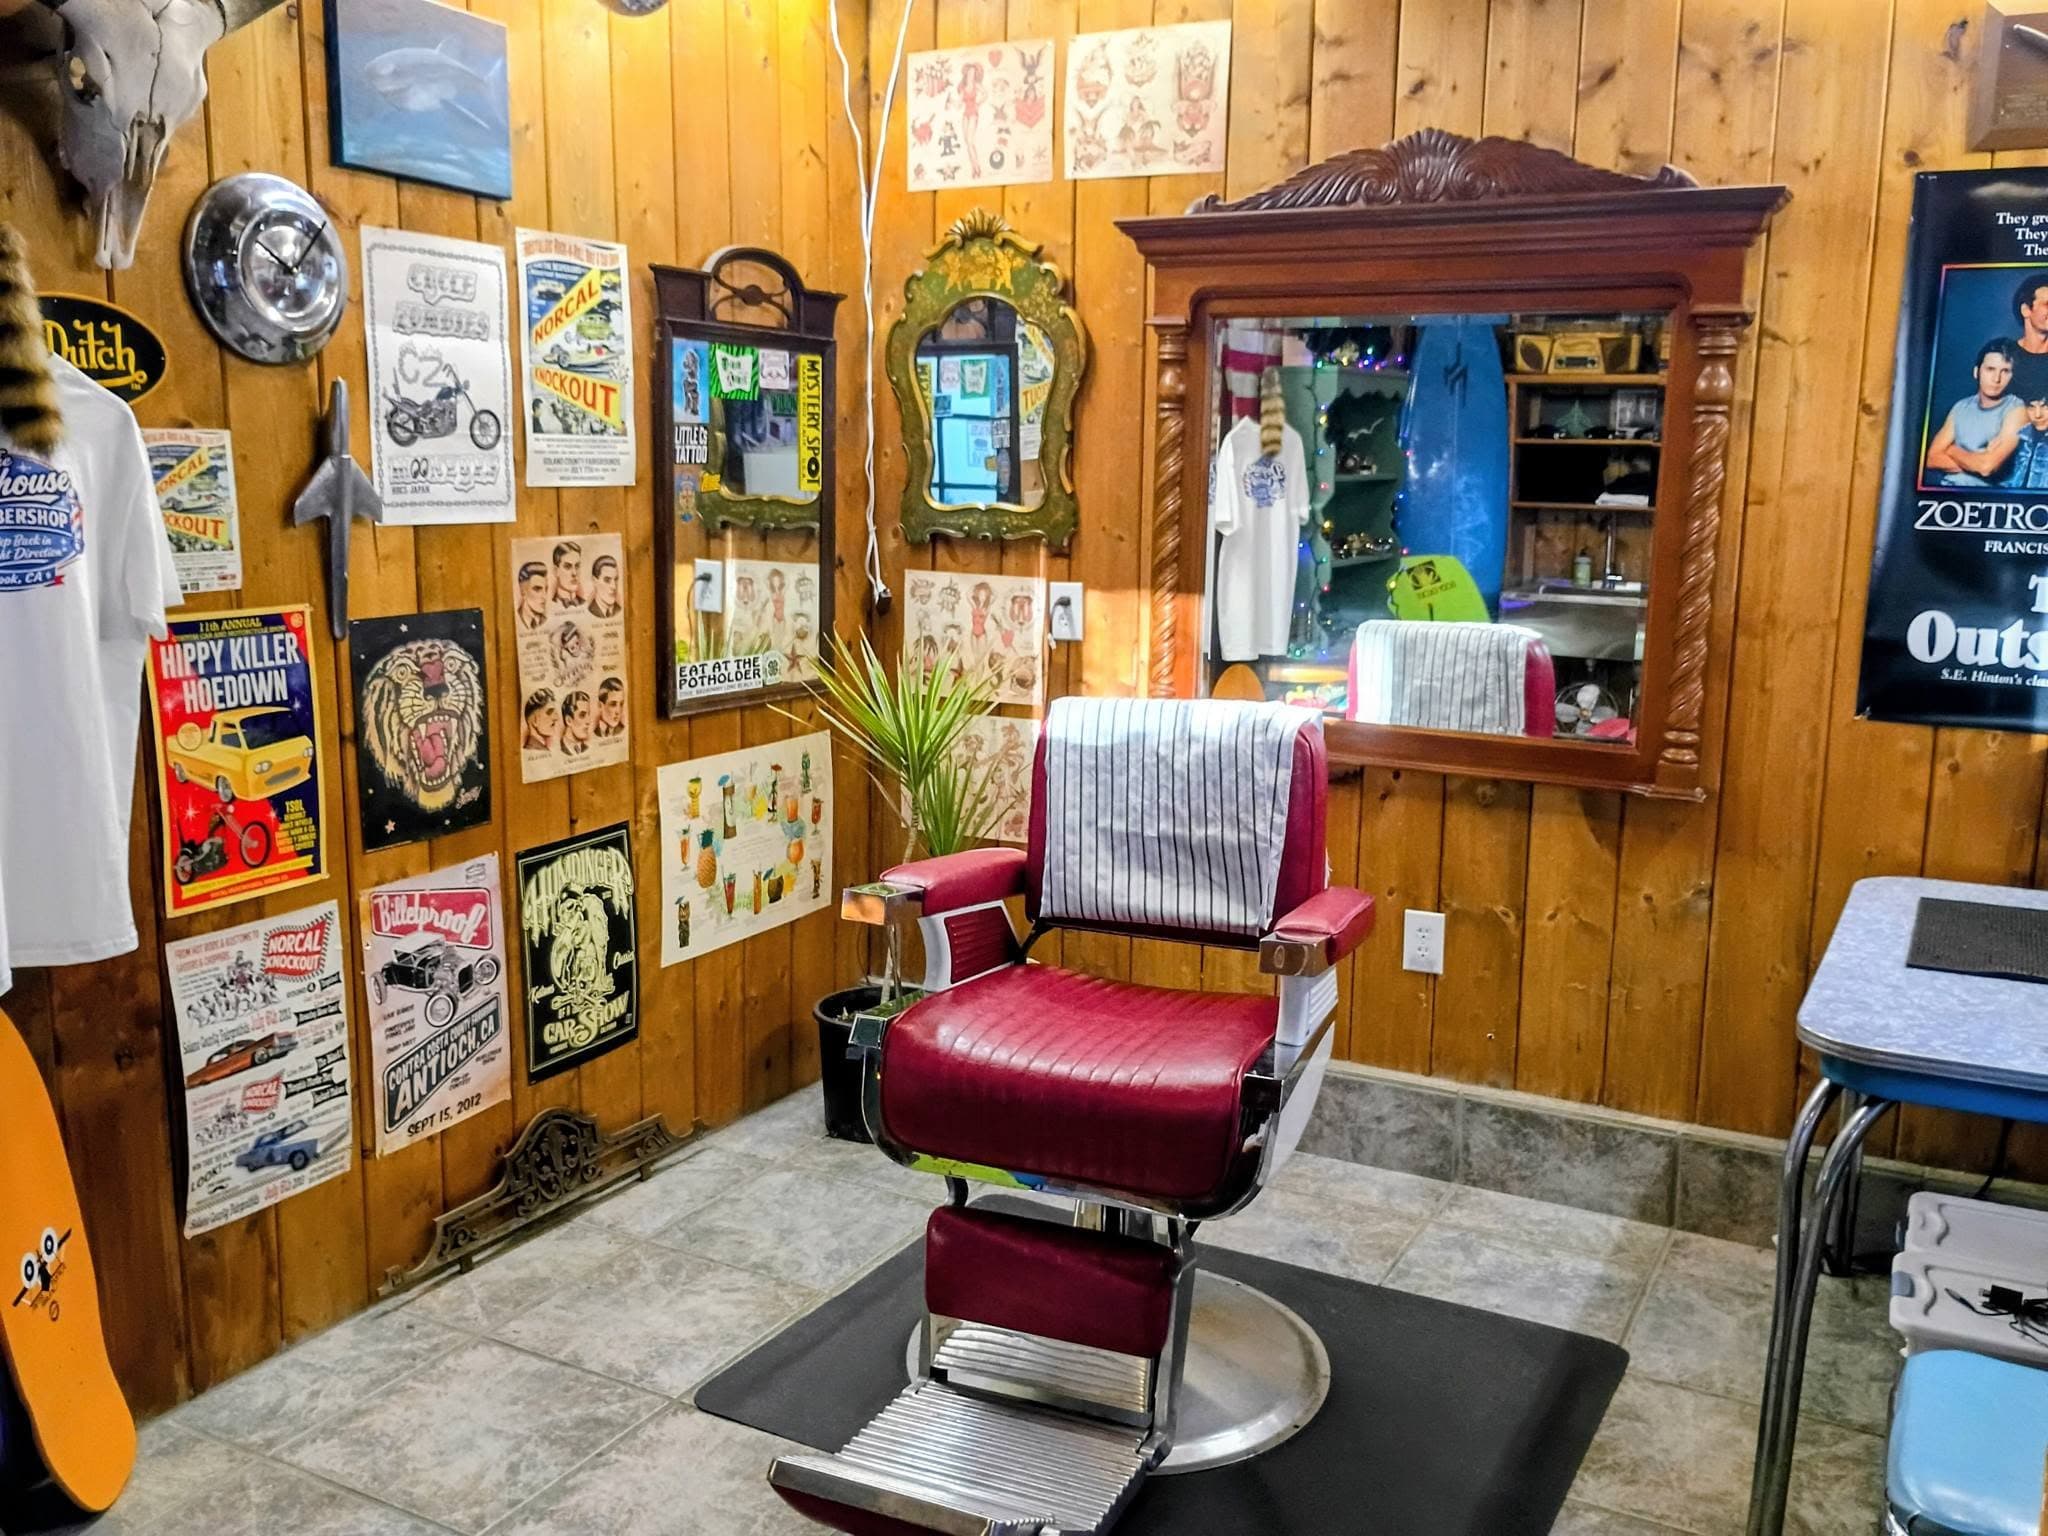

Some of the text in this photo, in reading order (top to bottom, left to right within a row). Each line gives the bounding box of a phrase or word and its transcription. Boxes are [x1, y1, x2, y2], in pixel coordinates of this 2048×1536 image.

[1996, 212, 2028, 226] They
[2015, 228, 2048, 242] They
[534, 280, 599, 343] NORCAL
[43, 319, 136, 374] Dutch
[398, 343, 447, 388] CZ
[534, 367, 617, 417] KNOCKOUT
[675, 426, 699, 445] LITTLE
[806, 359, 820, 484] MYSTERY SPOT
[675, 445, 708, 464] TATTOO
[157, 455, 206, 493] ORCAL
[164, 513, 224, 540] CKOUT
[1984, 540, 2048, 554] FRANCIS
[25, 571, 42, 584] CA
[221, 617, 262, 631] ANNUAL
[160, 632, 301, 680] HIPPY KILLER
[679, 656, 760, 677] EAT AT THE
[182, 669, 289, 714] HOEDOWN
[679, 668, 761, 690] POTHOLDER
[1941, 668, 1967, 681] S.E.
[1971, 670, 2022, 685] Hinton's
[373, 893, 486, 944] Billetproof
[268, 928, 322, 954] NORCAL
[264, 953, 321, 971] KNOCKOUT
[543, 1019, 577, 1045] CAR
[568, 990, 630, 1048] SHOW
[389, 1050, 425, 1091] CONTRA
[426, 1032, 449, 1060] COSTA
[394, 1027, 481, 1120] ANTIOCH,
[481, 1014, 495, 1041] CA
[407, 1093, 482, 1137] SEPT 15, 2012
